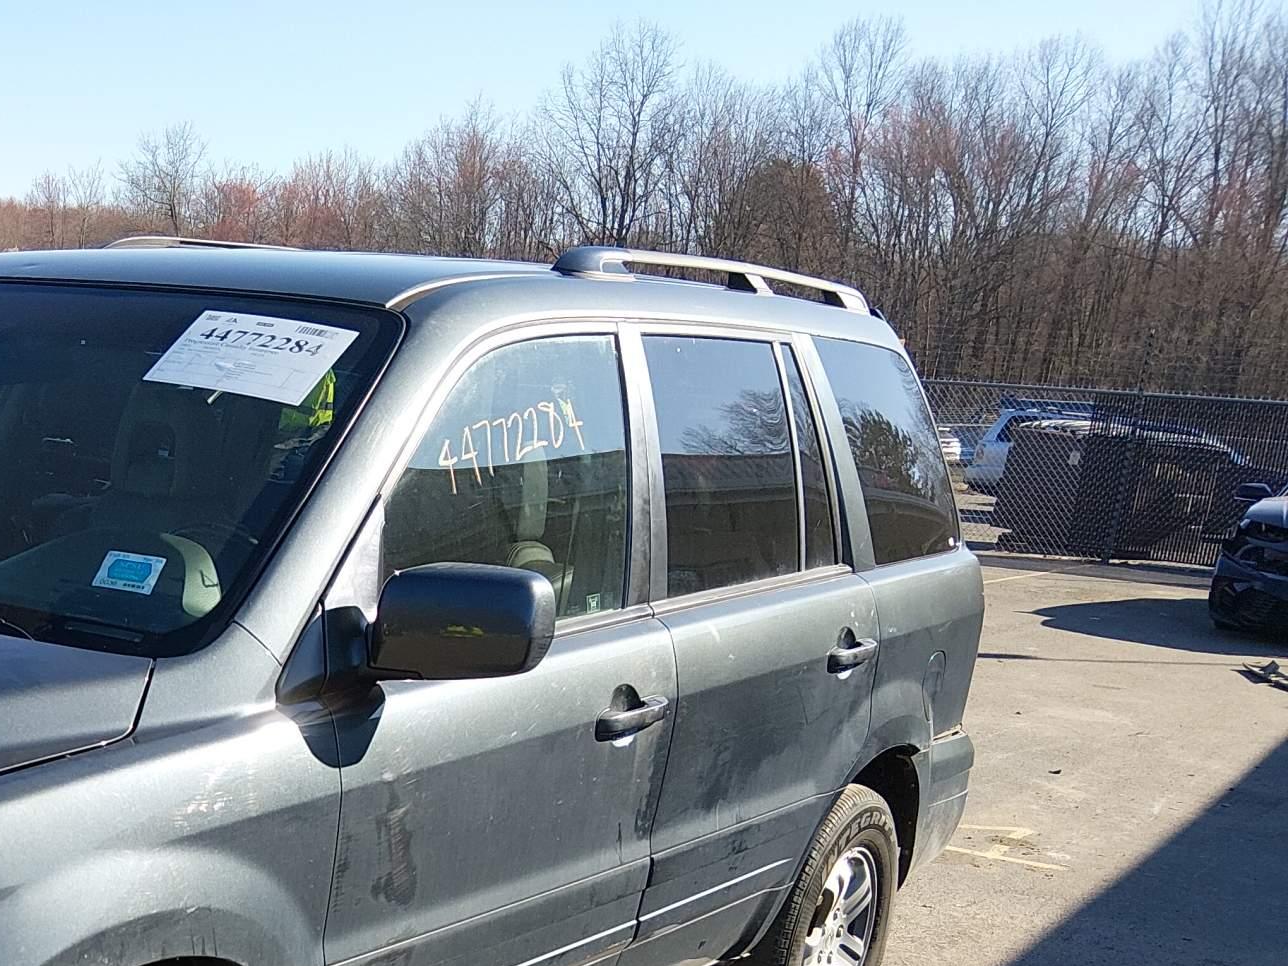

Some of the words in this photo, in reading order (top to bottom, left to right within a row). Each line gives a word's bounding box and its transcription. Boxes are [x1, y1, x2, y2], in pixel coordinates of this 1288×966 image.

[199, 327, 324, 357] 44772284
[438, 398, 585, 496] 44772284
[821, 811, 894, 888] INTEGRITY
